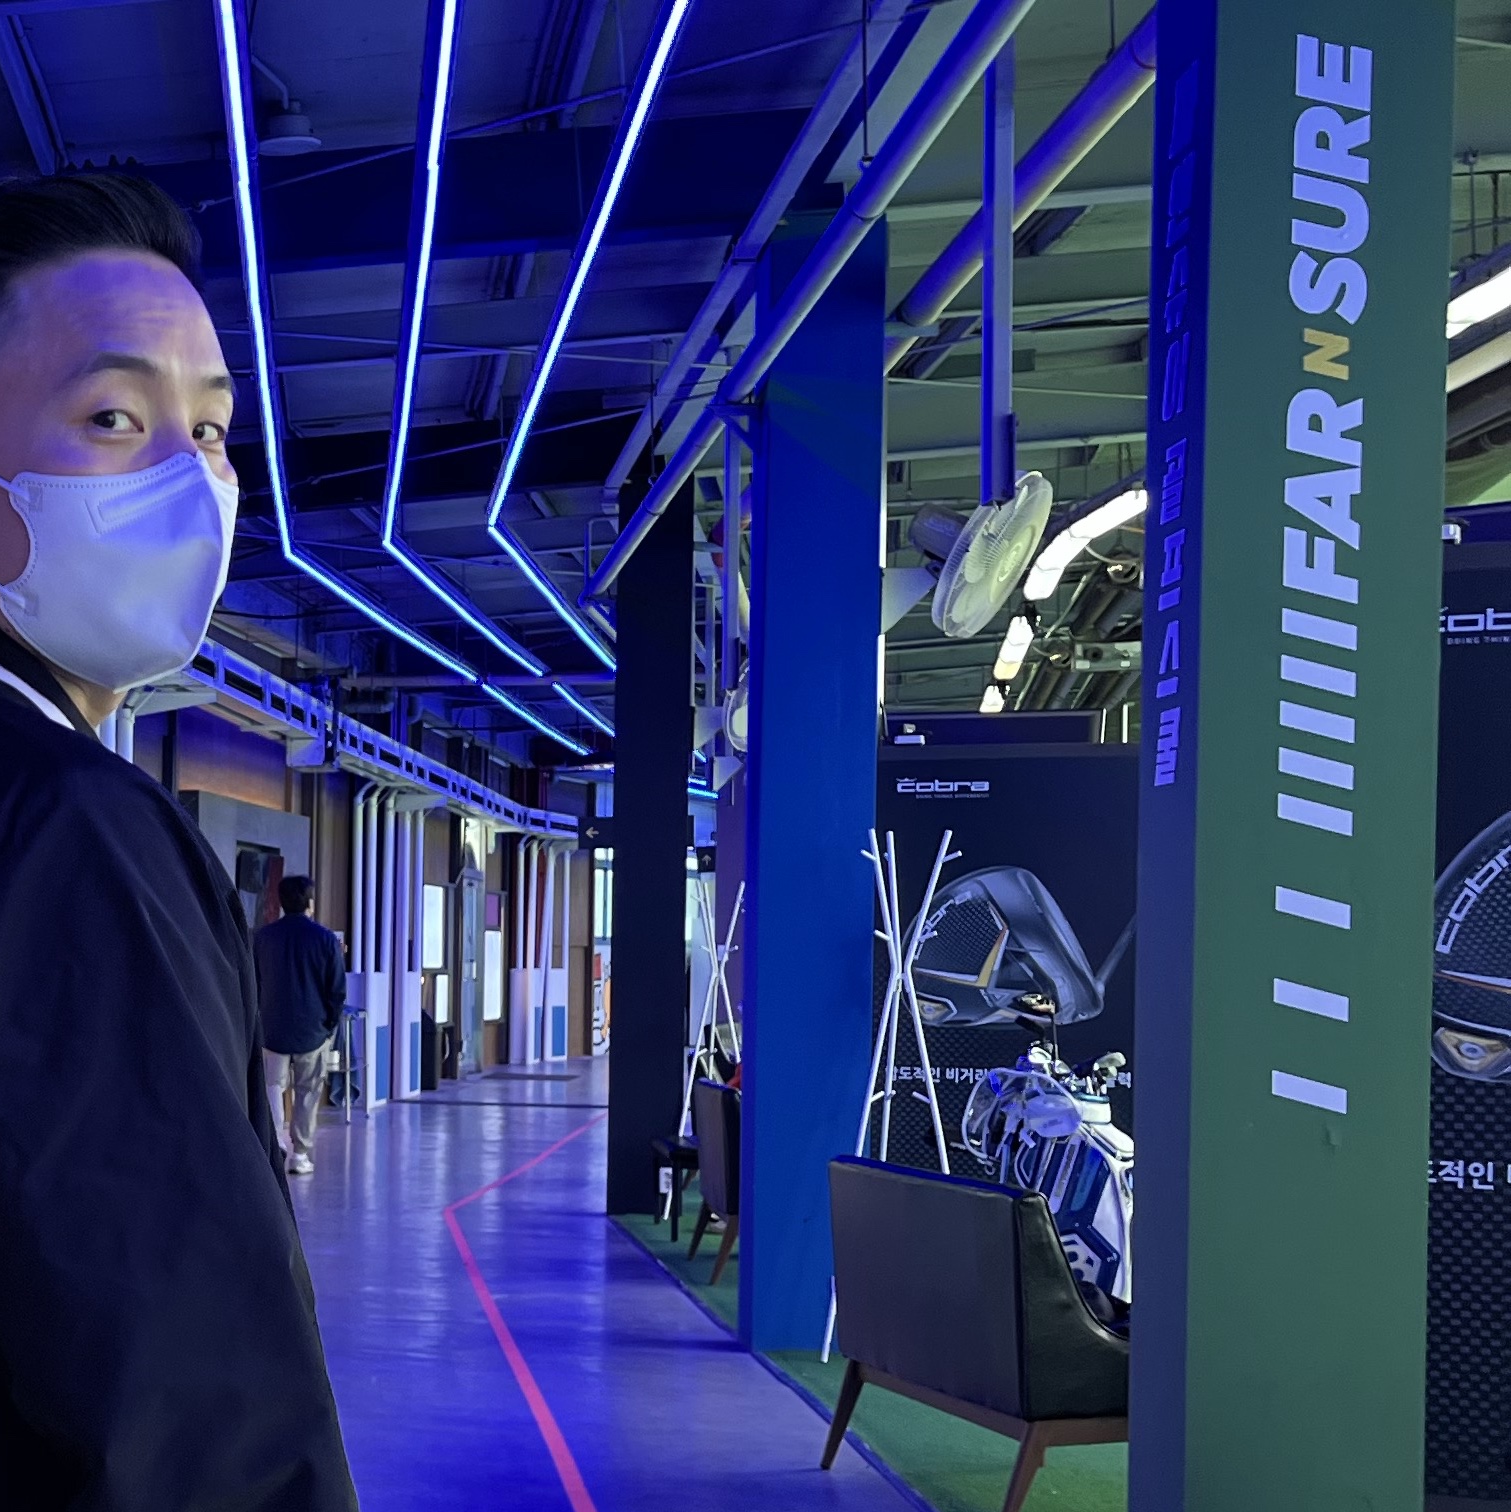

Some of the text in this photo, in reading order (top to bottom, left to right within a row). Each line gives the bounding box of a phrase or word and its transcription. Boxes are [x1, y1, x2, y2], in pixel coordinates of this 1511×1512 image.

[1282, 33, 1373, 606] FAR N SURE
[896, 777, 990, 793] cobra
